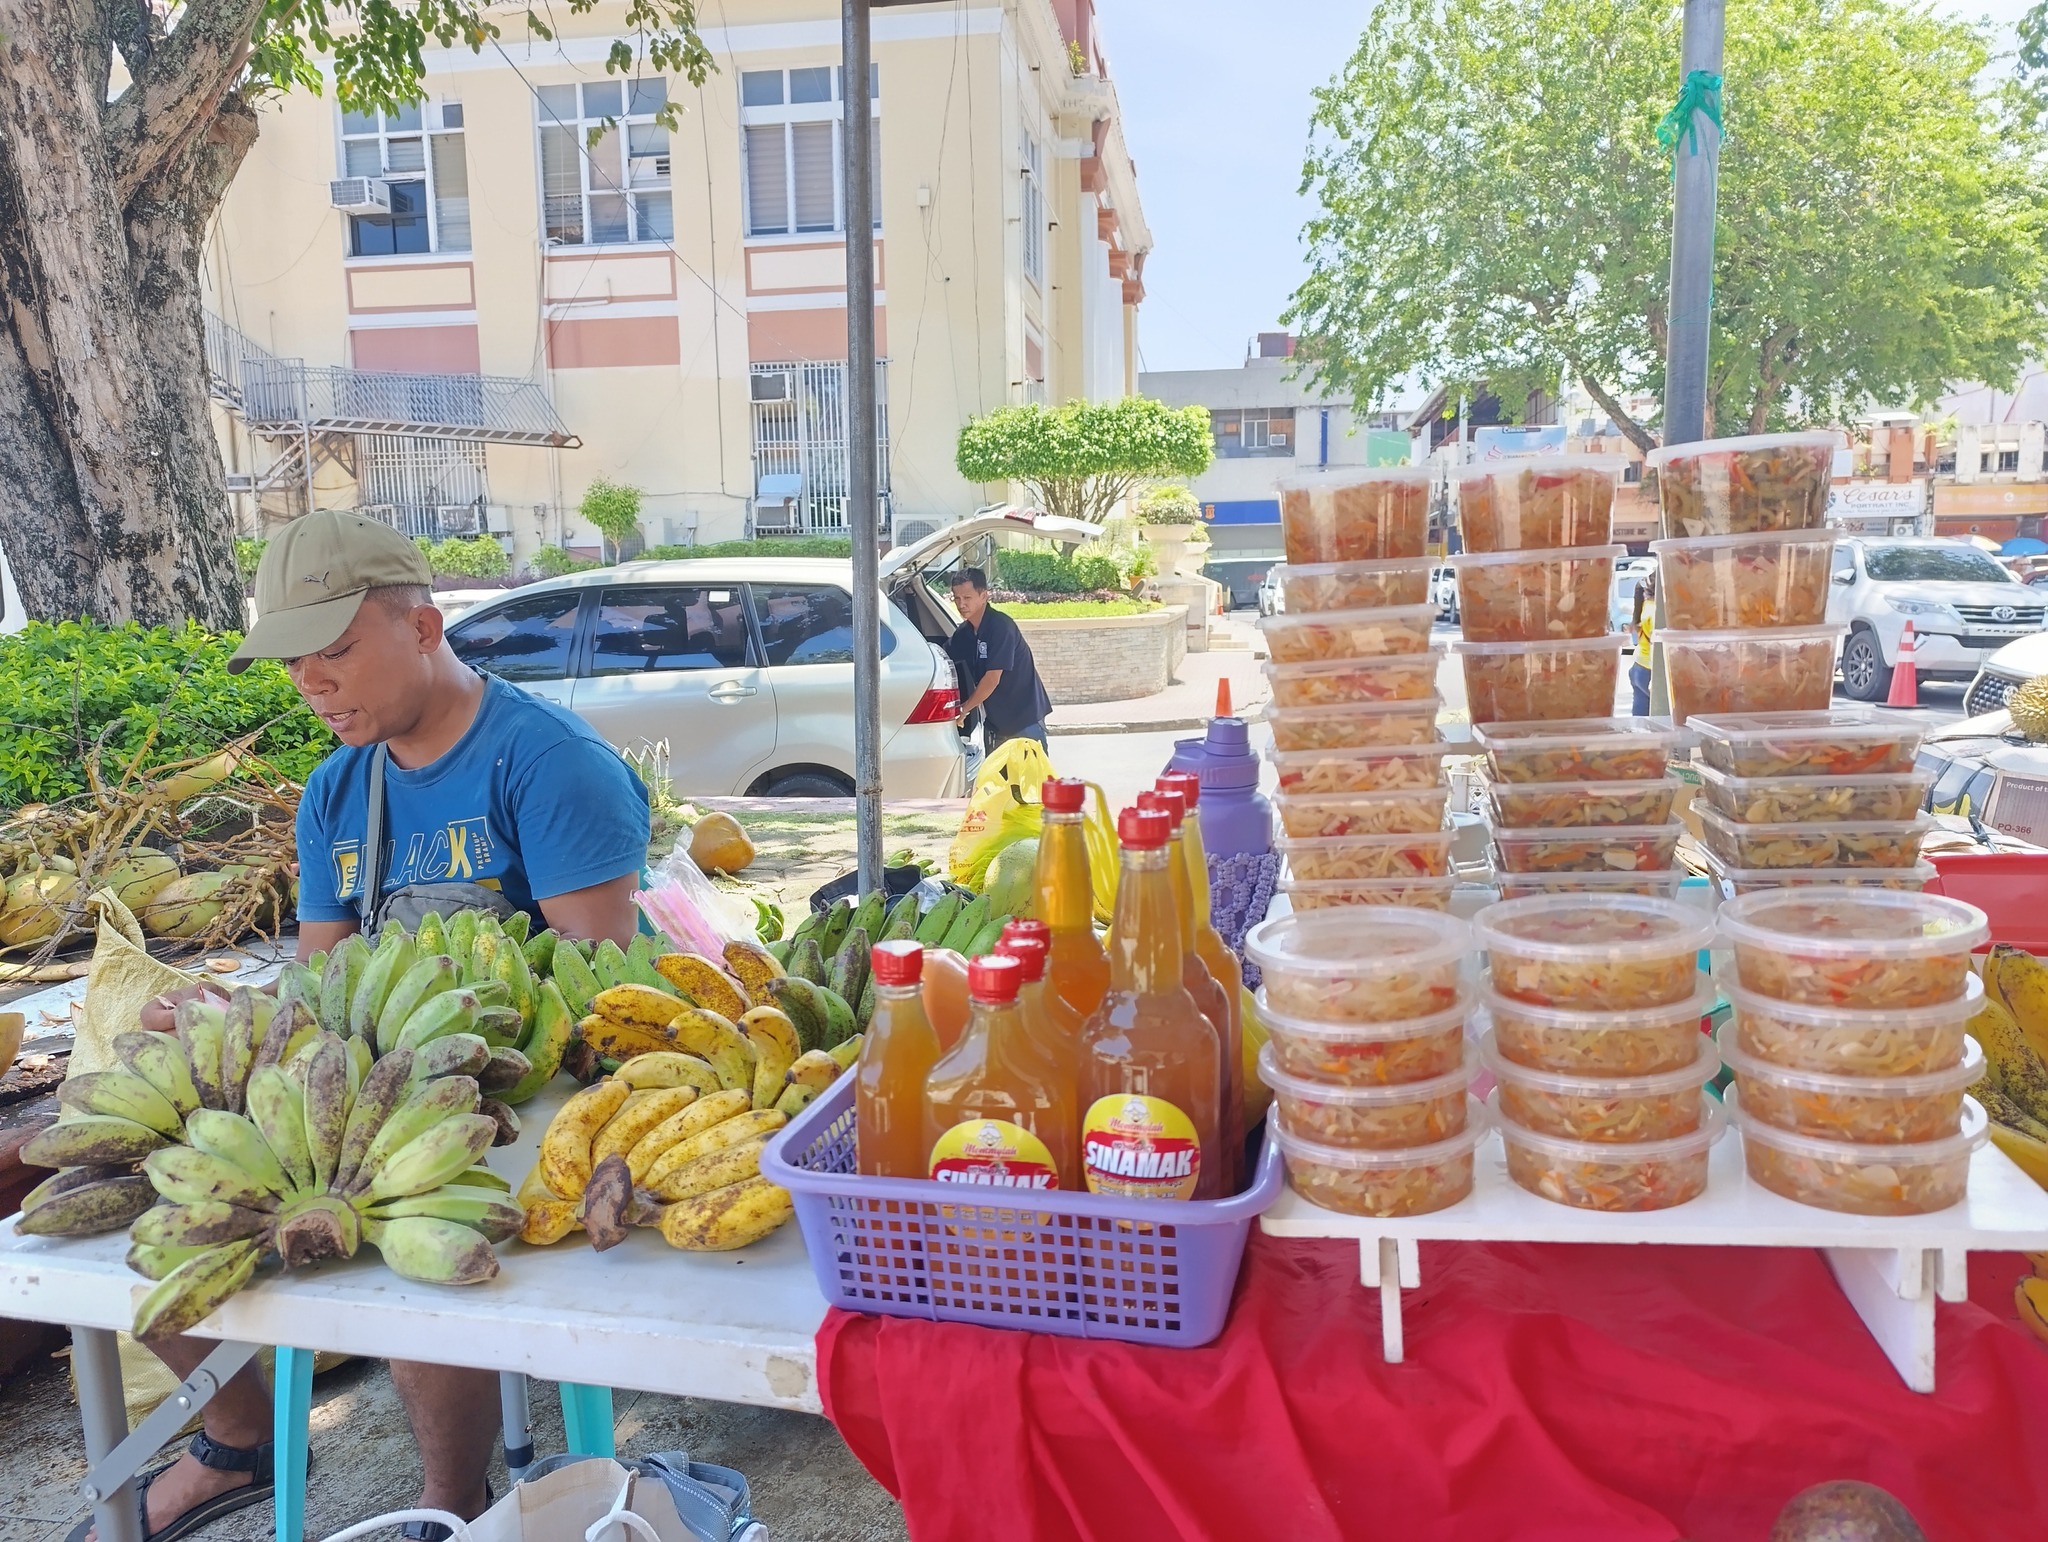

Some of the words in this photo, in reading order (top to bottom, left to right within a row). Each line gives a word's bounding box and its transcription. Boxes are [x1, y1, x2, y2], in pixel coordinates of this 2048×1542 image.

[1843, 488, 1913, 505] Cesar's
[2006, 781, 2034, 791] Product
[1997, 822, 2032, 834] PQ-366
[471, 832, 484, 870] PREMIUM
[480, 836, 491, 863] BRAND
[1086, 1140, 1195, 1179] SINAMAK
